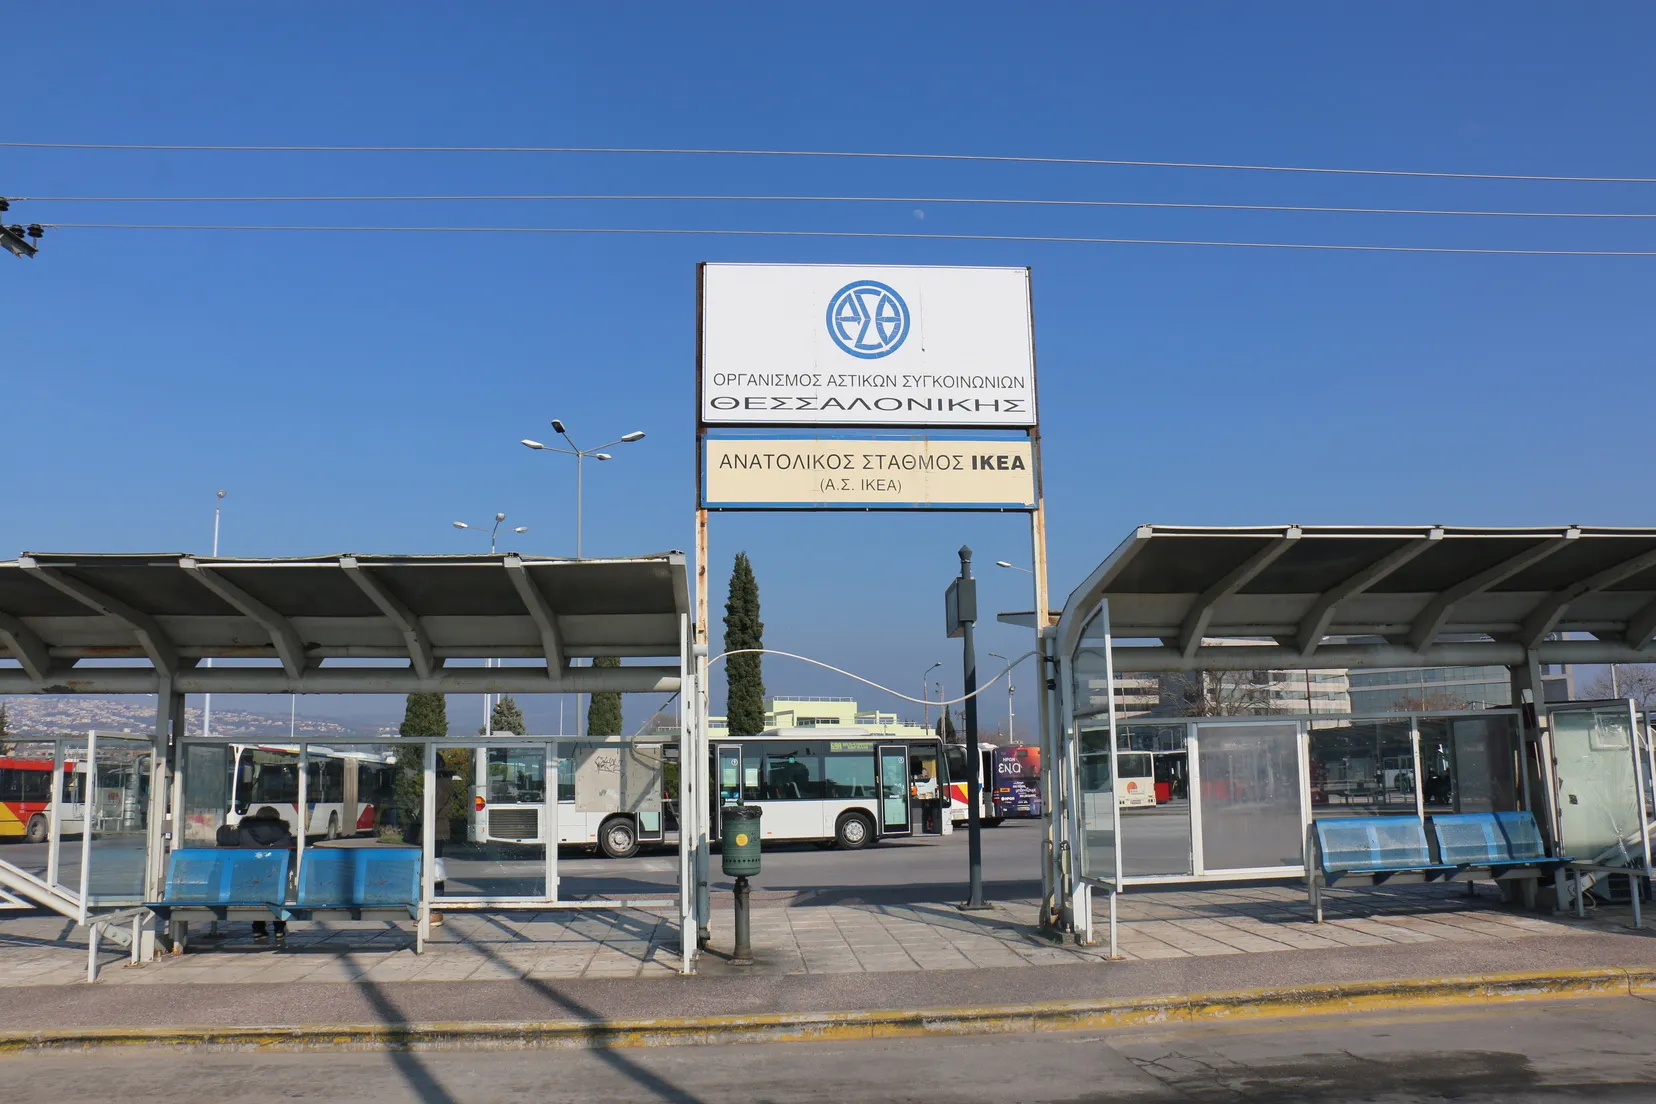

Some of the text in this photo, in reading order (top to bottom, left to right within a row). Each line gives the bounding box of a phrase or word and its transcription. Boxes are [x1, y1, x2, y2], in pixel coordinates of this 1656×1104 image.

[713, 373, 1025, 389] ΟΡΓΑΝΙΣΜΟΣ ΑΣΤΙΚΩΝ ΣΥΓΚΟΙΝΩΝΙΩΝ
[710, 396, 1026, 413] ΘΕΣΣΑΛΟΝΙΚΗΣ
[719, 453, 1026, 471] ΑΝΑΤΟΛΙΚΟΣ ΣΤΑΘΜΟΣ IKEA
